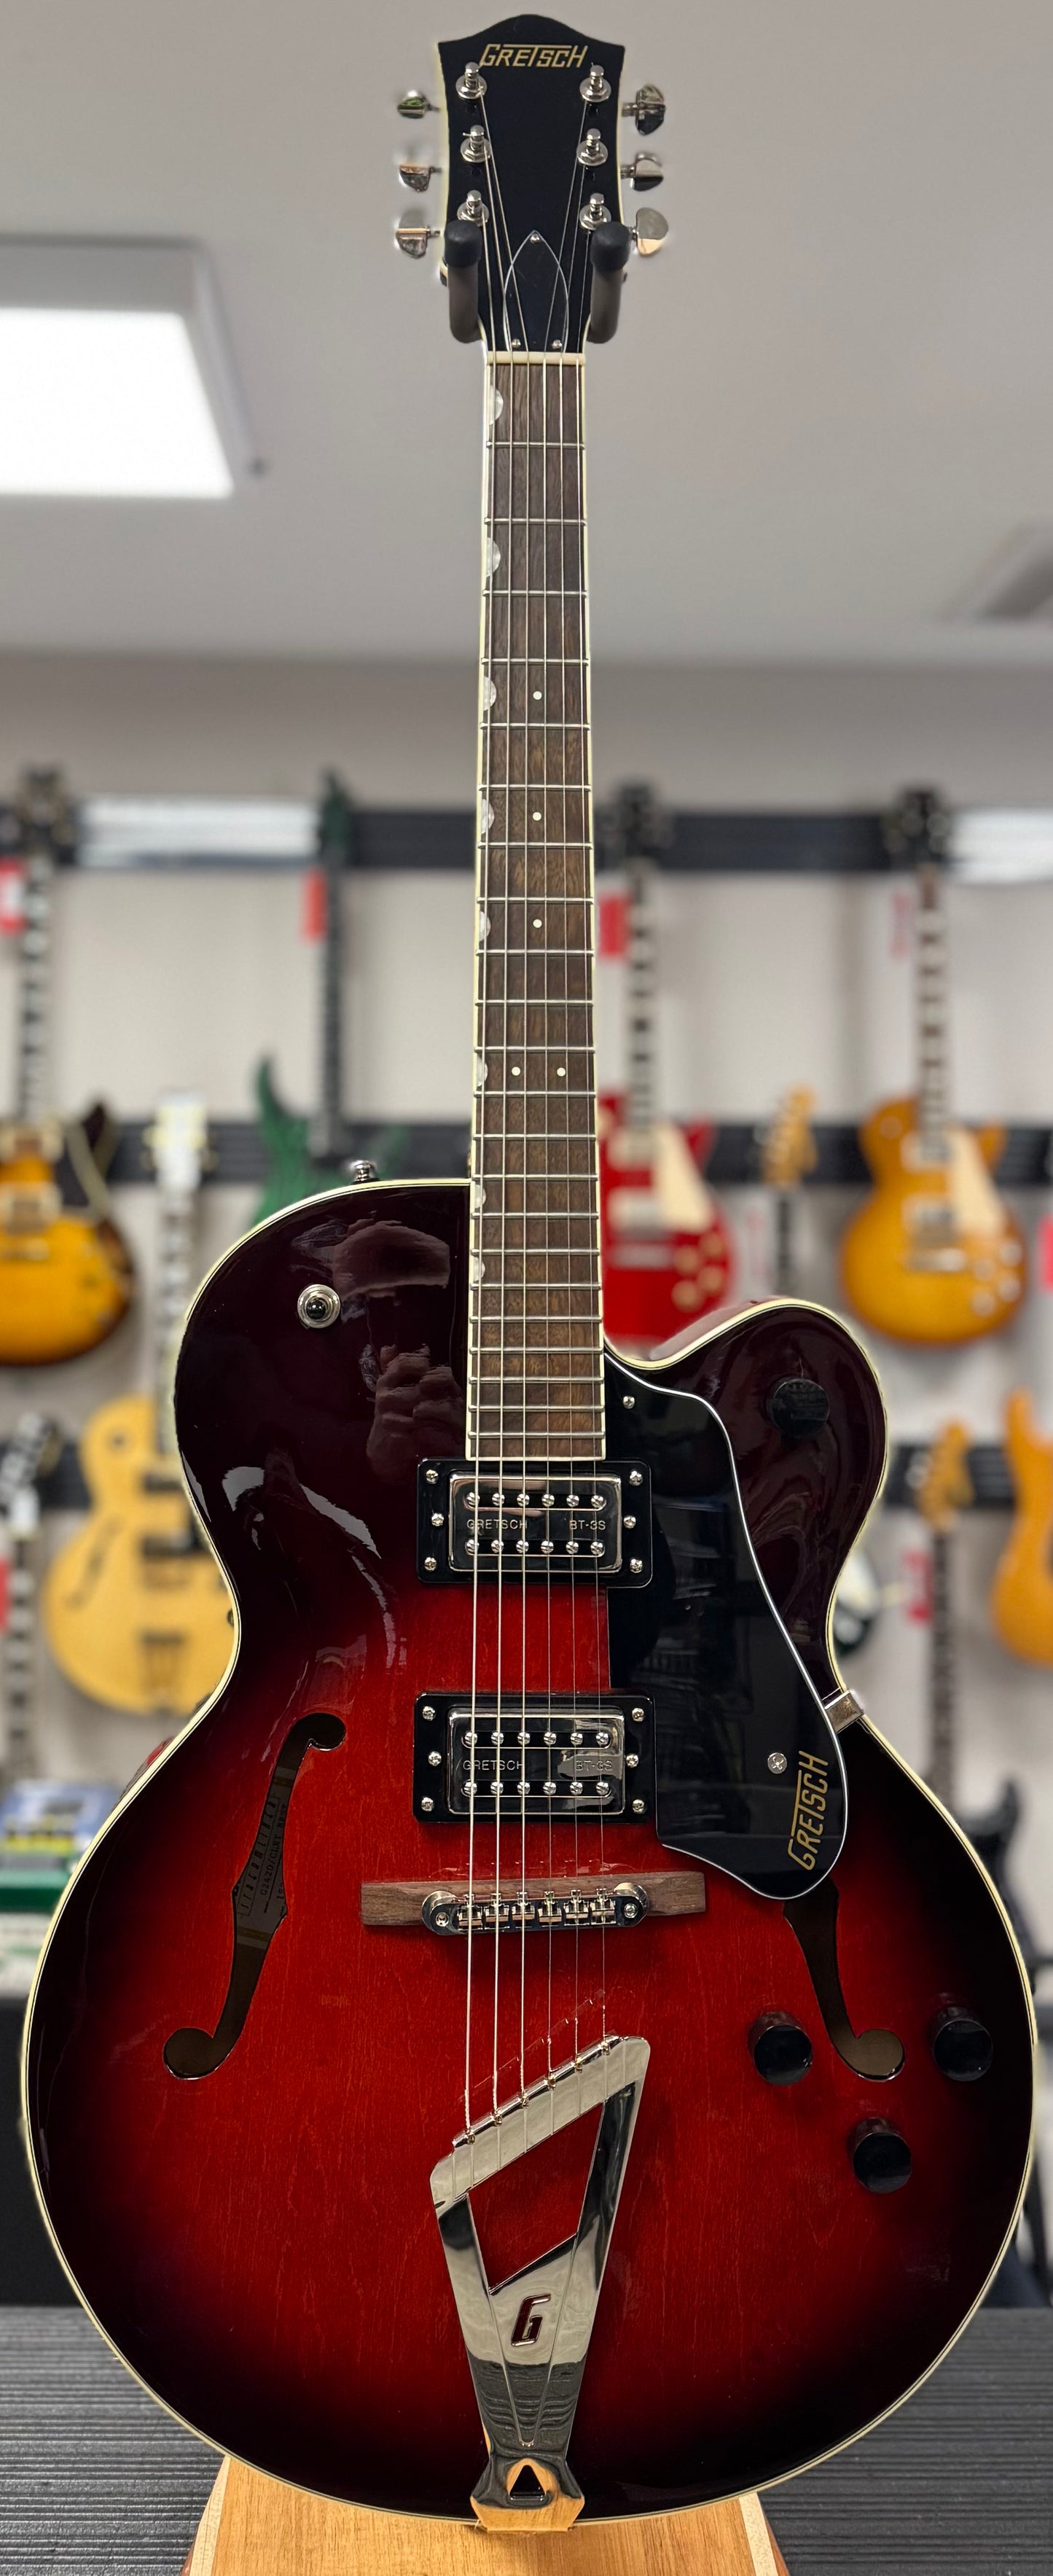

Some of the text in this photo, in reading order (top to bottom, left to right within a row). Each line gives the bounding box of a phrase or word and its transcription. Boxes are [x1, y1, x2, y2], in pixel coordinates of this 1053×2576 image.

[479, 44, 588, 68] GRETSCH
[466, 1519, 528, 1529] GRETSCH
[569, 1520, 606, 1530] BT-3S
[463, 1760, 525, 1771] GRETSCH
[787, 1750, 829, 1870] GRETSCH
[511, 2293, 551, 2347] G
